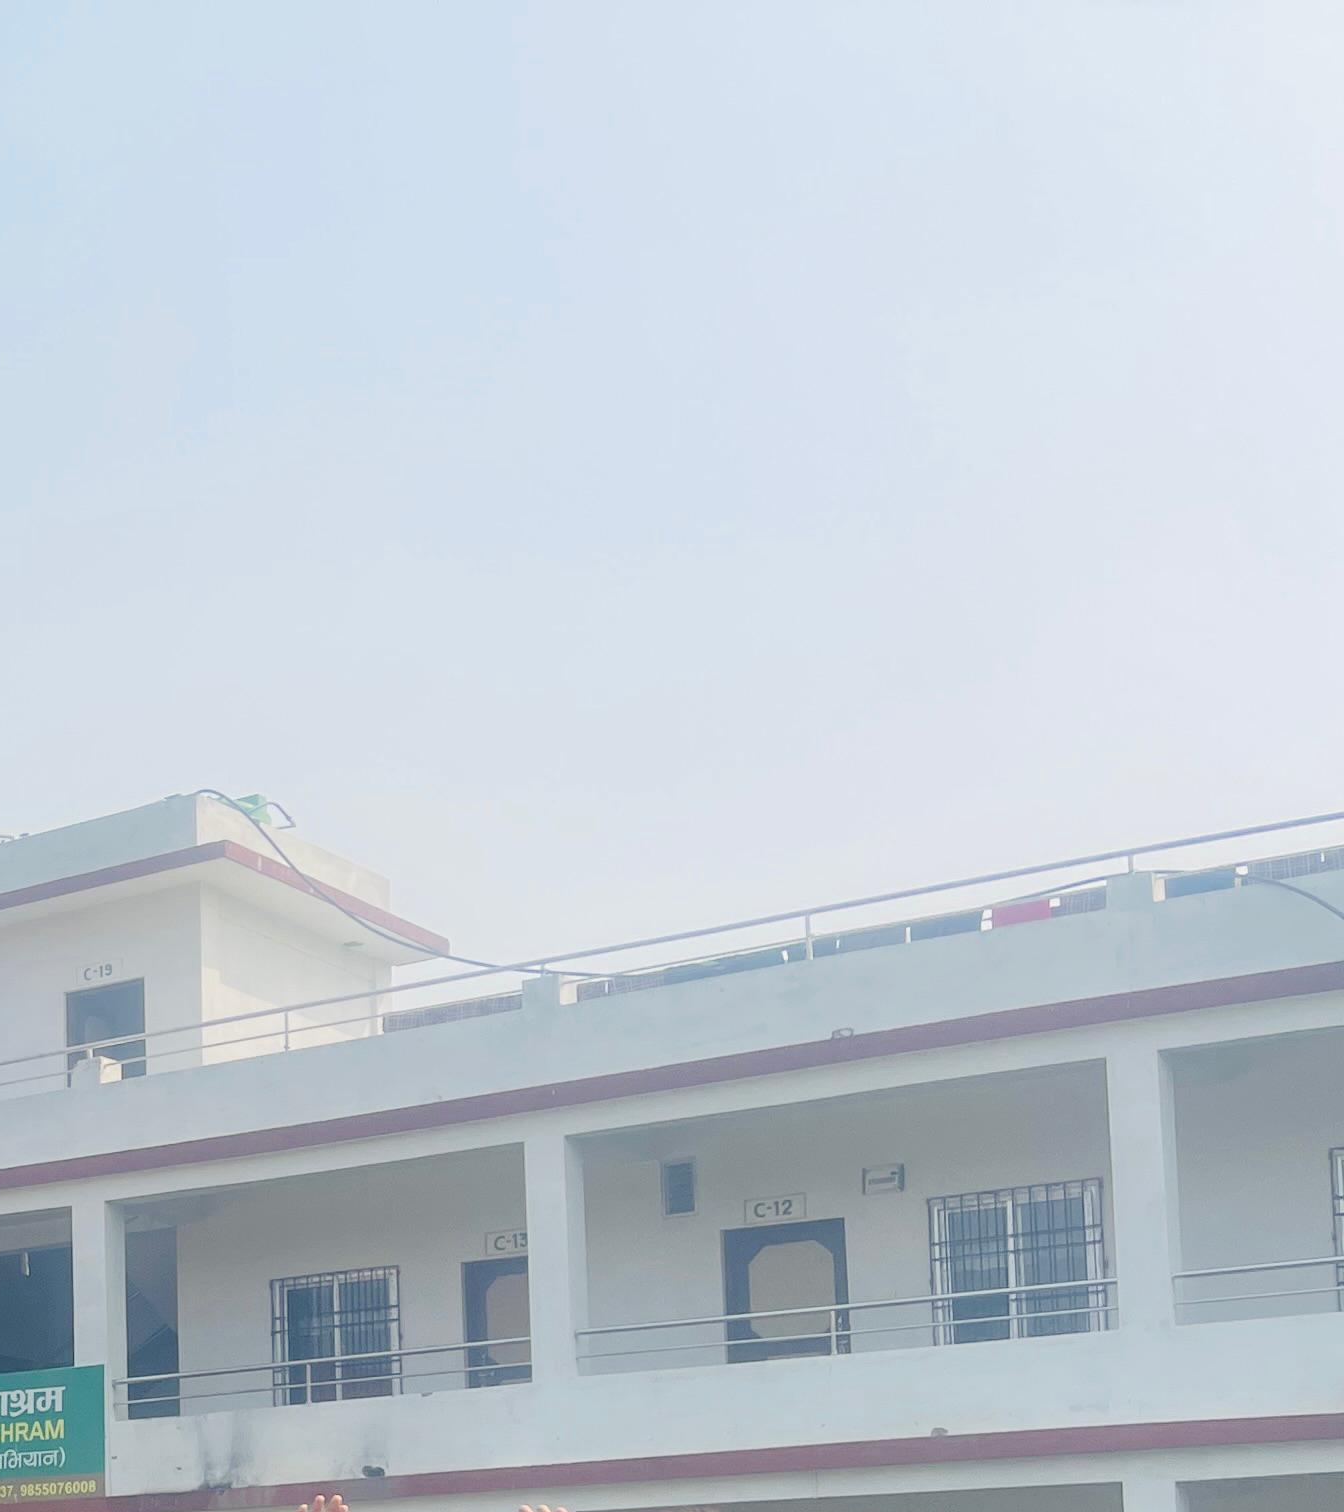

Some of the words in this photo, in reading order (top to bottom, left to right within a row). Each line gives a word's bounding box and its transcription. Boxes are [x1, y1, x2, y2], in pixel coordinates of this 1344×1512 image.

[83, 963, 113, 981] C-19
[753, 1199, 793, 1218] C-12
[494, 1232, 528, 1251] C-13
